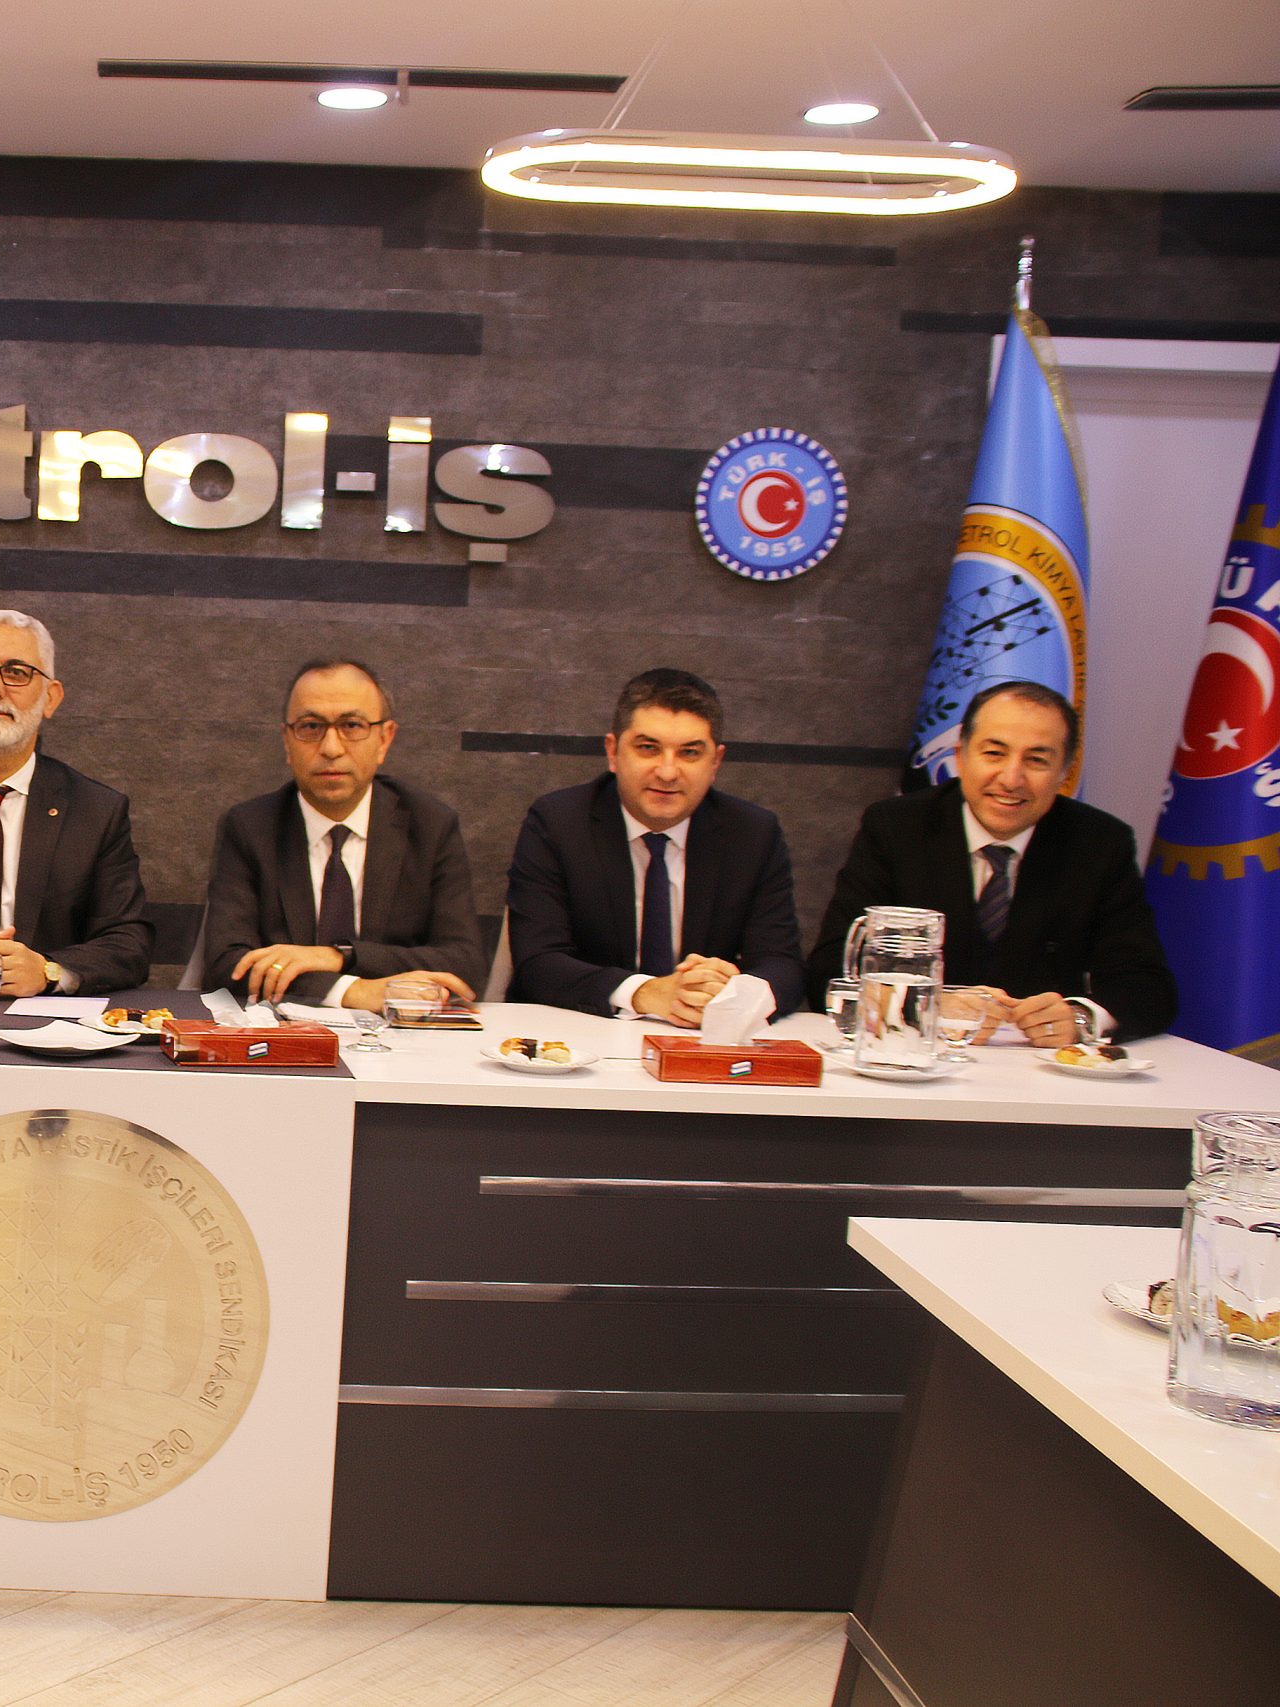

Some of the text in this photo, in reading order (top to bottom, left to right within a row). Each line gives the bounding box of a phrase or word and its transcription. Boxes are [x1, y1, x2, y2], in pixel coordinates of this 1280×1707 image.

[740, 536, 806, 557] 1952
[37, 1132, 139, 1173] LASTİK
[138, 1153, 233, 1256] İŞÇİLERİ
[198, 1259, 244, 1411] SENDİKASI
[119, 1427, 195, 1489] 1950
